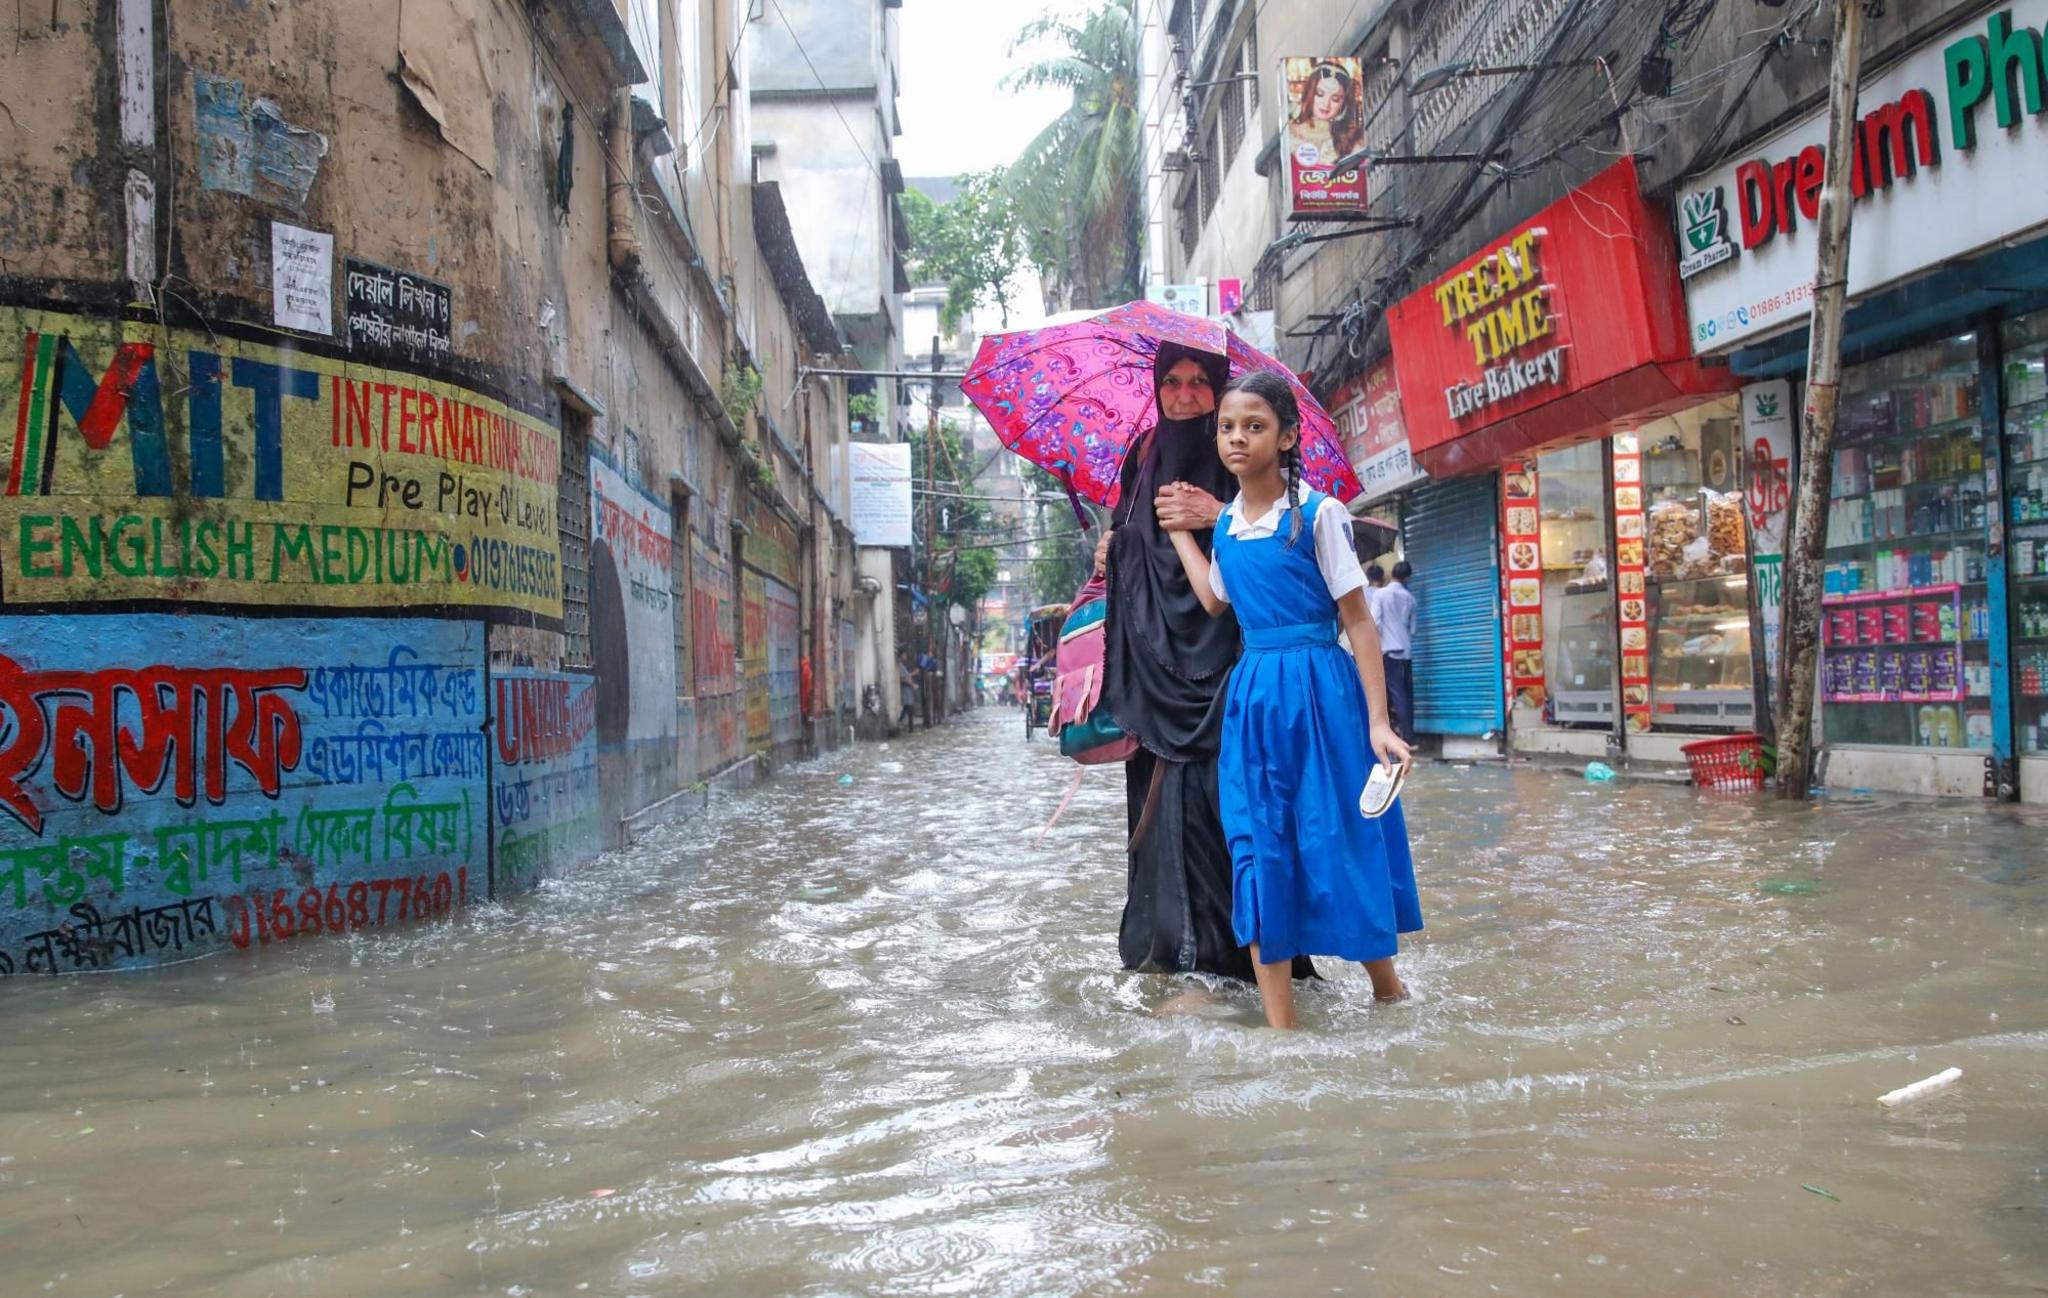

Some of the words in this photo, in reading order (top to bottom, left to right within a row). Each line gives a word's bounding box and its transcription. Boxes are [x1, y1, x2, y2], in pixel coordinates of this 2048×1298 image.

[1736, 89, 1938, 250] Drem
[1944, 10, 2048, 150] Ph
[348, 271, 394, 307] দেয়াল
[399, 276, 436, 319] লিখন
[1435, 229, 1540, 326] TREAT
[1682, 261, 1702, 276] Dream
[1704, 247, 1730, 266] Pharma
[1467, 288, 1551, 365] TIME
[4, 331, 320, 500] MIT
[1445, 379, 1485, 419] Live
[1484, 347, 1561, 402] Bakery
[332, 375, 526, 479] INTERNATIONAL
[346, 461, 423, 509] Pre
[516, 488, 552, 538] Level
[19, 514, 254, 579] ENGLISH
[270, 523, 453, 585] MEDIUM
[305, 719, 429, 784] এডমিশন
